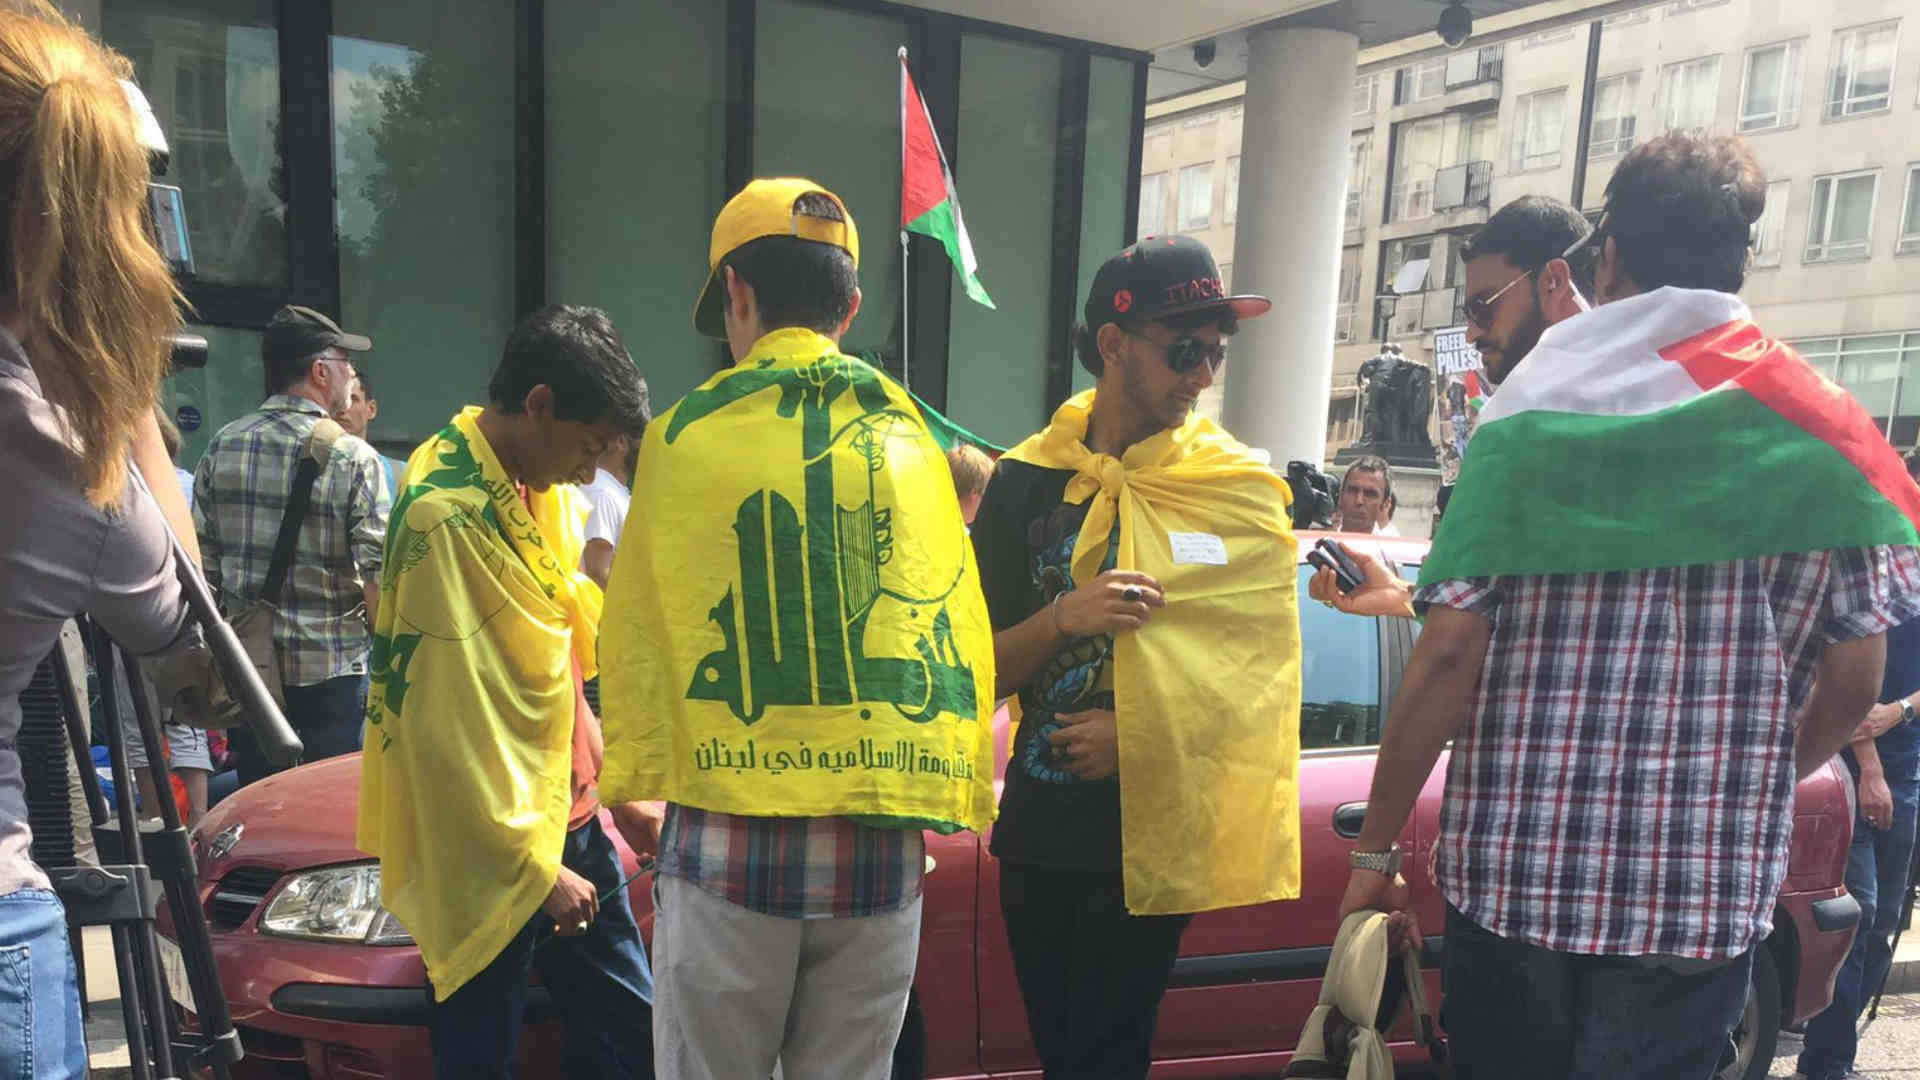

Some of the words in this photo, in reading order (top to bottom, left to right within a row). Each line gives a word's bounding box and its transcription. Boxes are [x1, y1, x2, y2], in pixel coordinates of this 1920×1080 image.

[1436, 333, 1466, 353] FREED
[695, 737, 756, 774] لبنان
[763, 741, 813, 775] في
